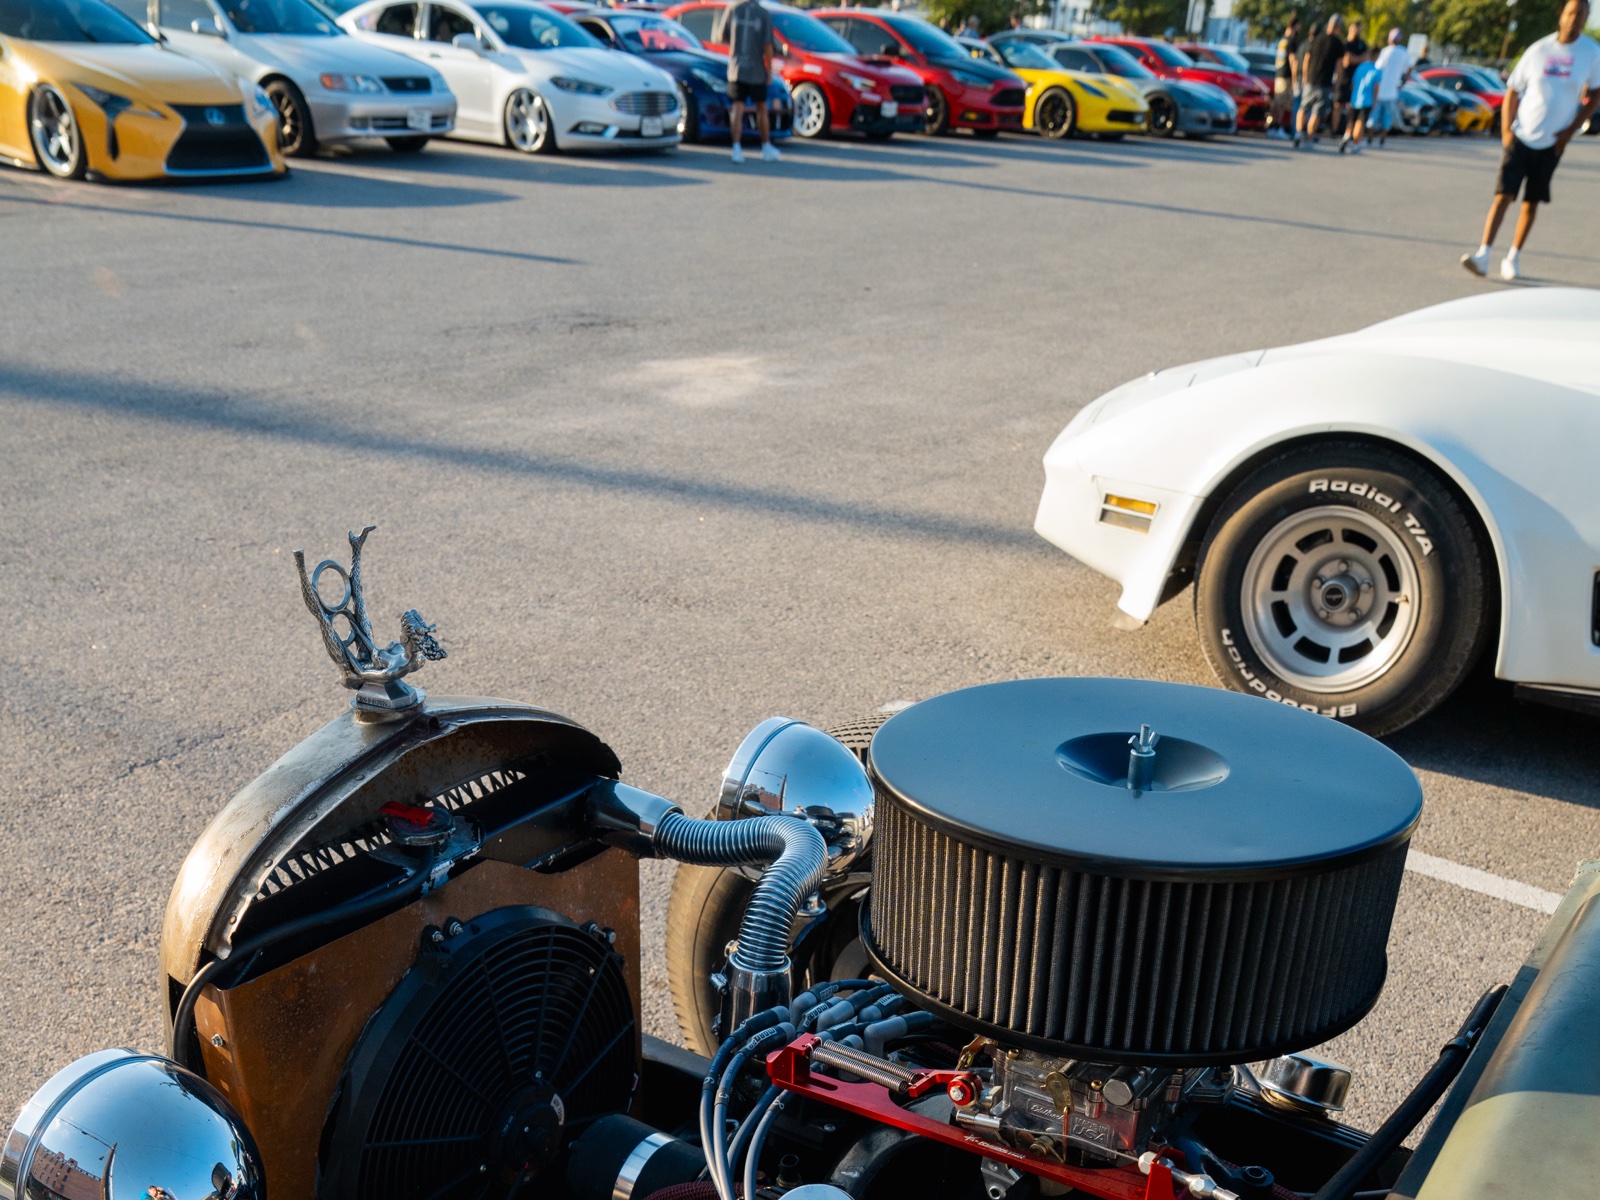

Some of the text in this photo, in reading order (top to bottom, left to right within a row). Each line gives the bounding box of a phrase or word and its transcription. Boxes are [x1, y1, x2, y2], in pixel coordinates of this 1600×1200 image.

[1308, 479, 1433, 556] Radial T/A
[1075, 1117, 1098, 1130] MADE
[1072, 1124, 1105, 1143] USA
